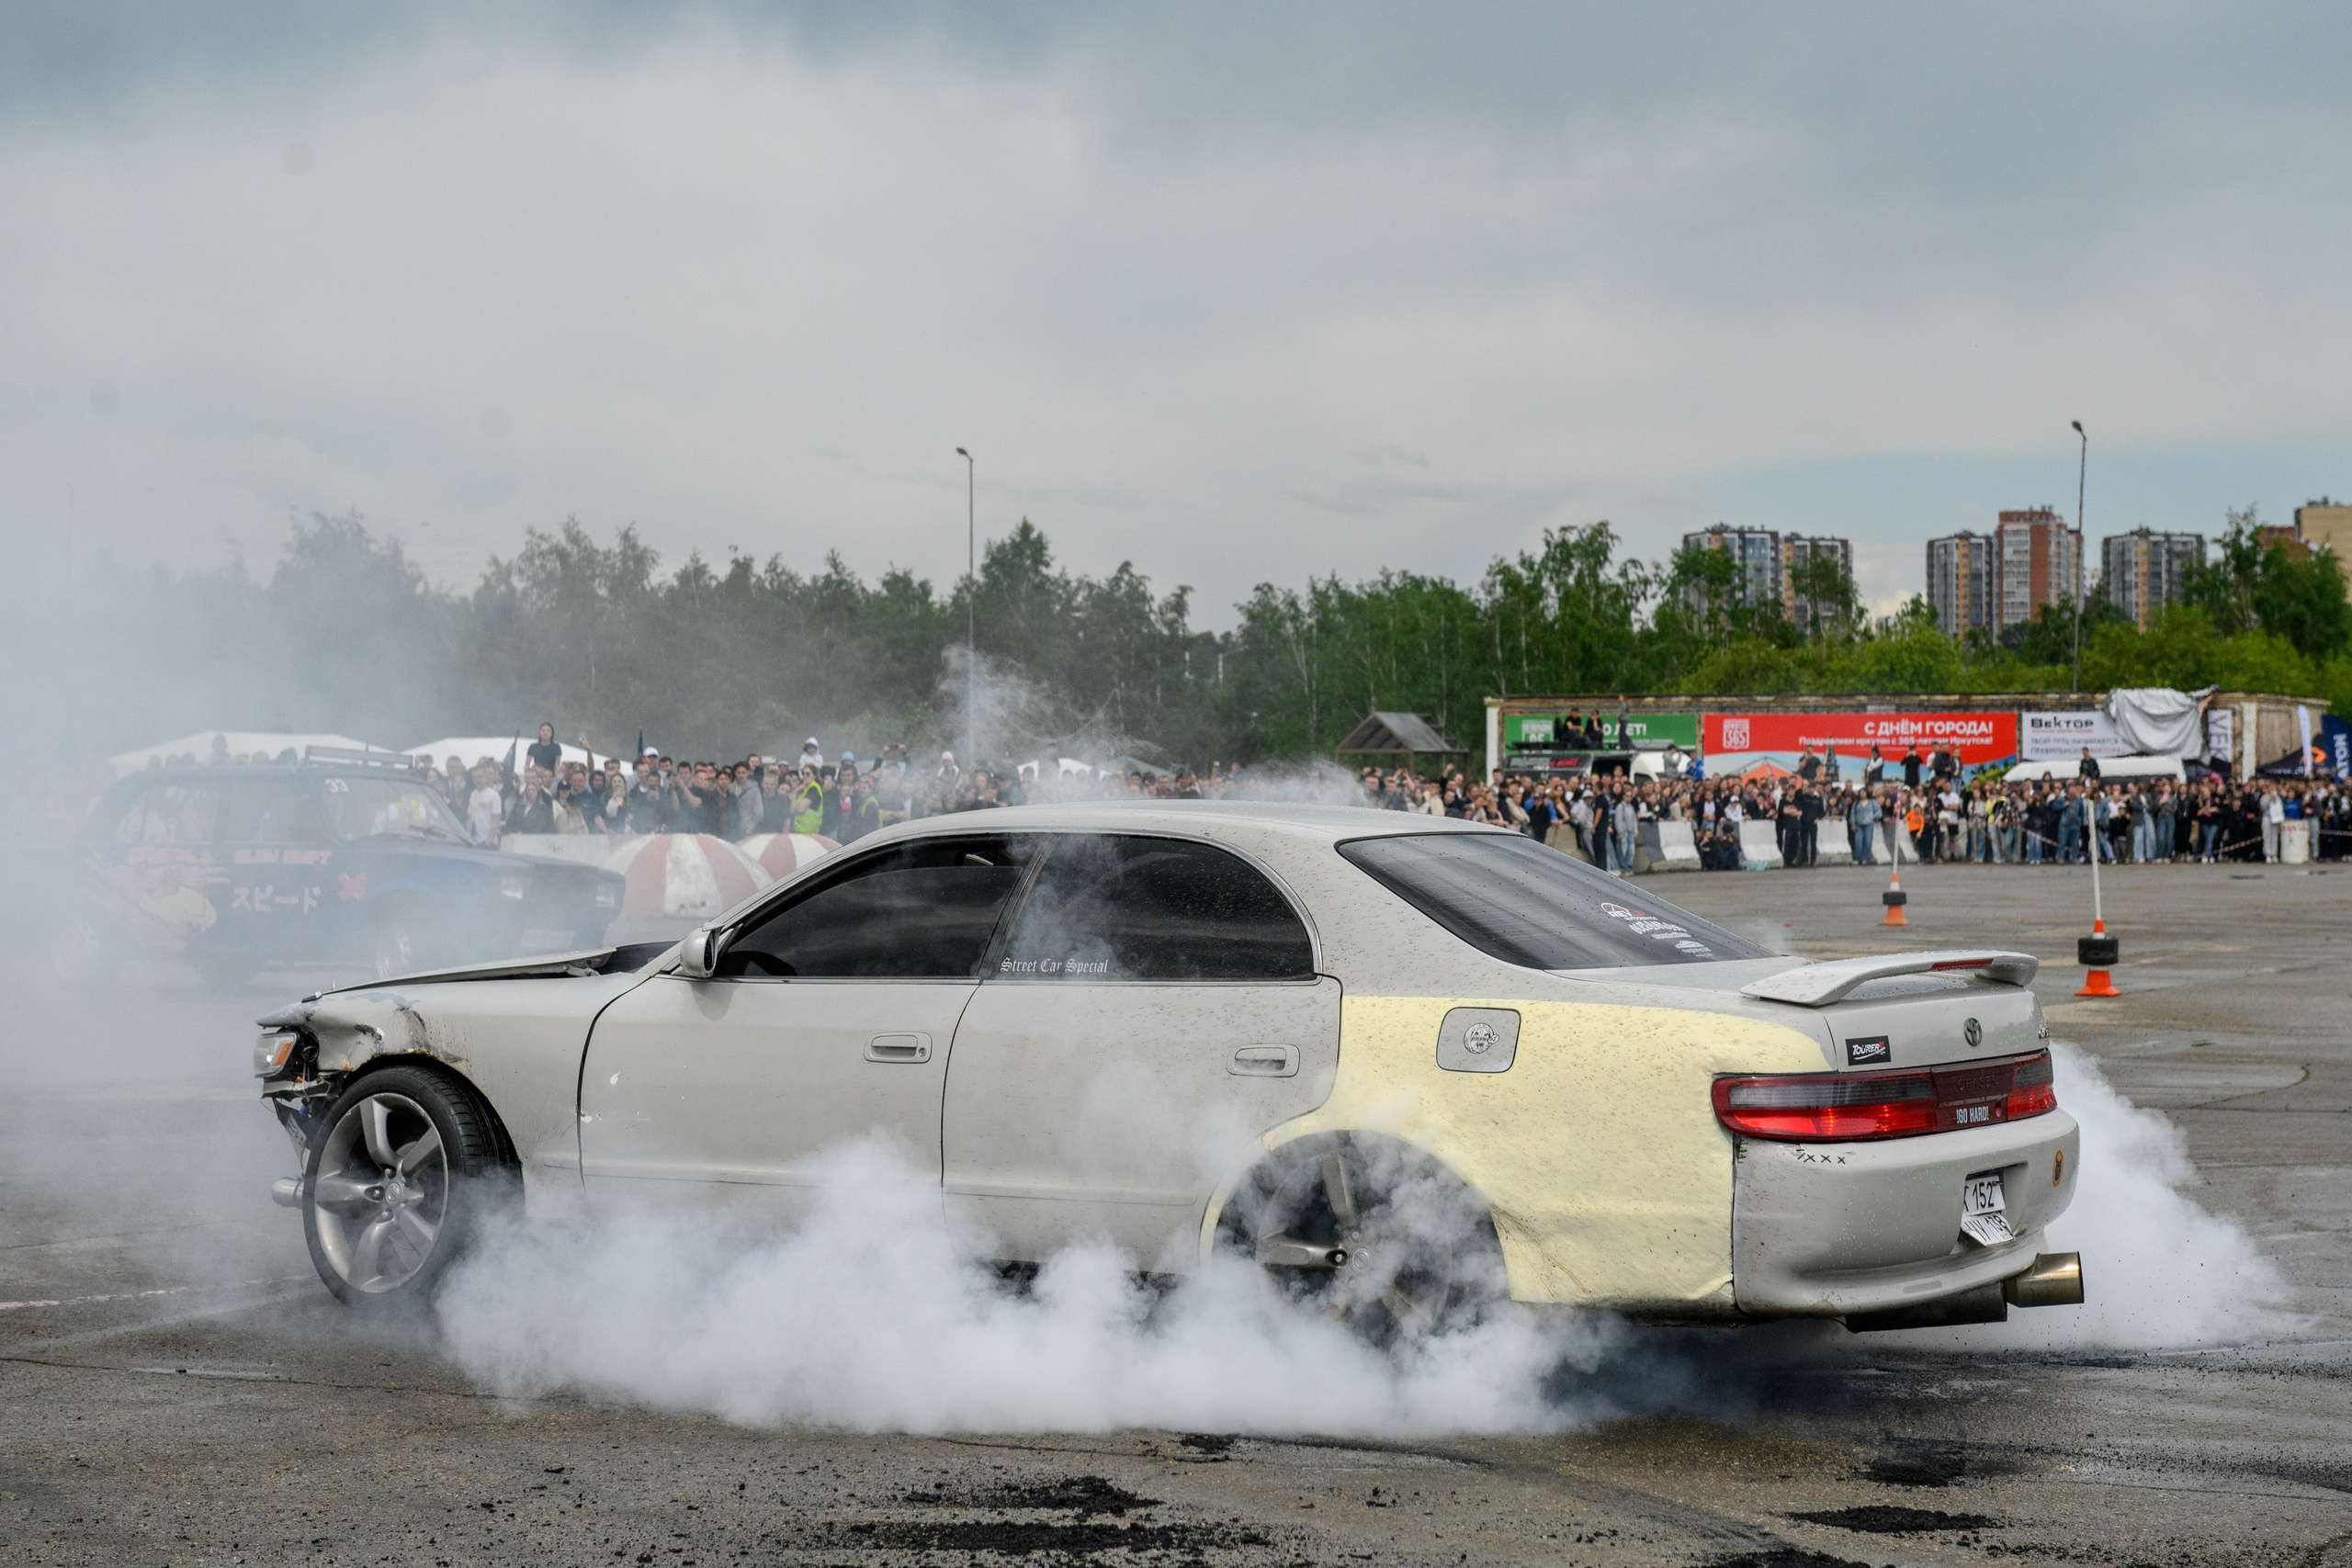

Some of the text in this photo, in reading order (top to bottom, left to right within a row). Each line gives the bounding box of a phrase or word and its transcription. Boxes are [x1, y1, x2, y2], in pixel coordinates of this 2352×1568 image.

[1864, 718, 1993, 736] С ДНЁМ ГОРОДА!
[1725, 729, 1747, 747] 365
[325, 778, 348, 792] 33
[232, 884, 322, 914] スピード
[1000, 957, 1110, 975] Street Car Special
[1956, 1106, 1989, 1123] !GO HARD!
[1972, 1181, 1995, 1210] 152
